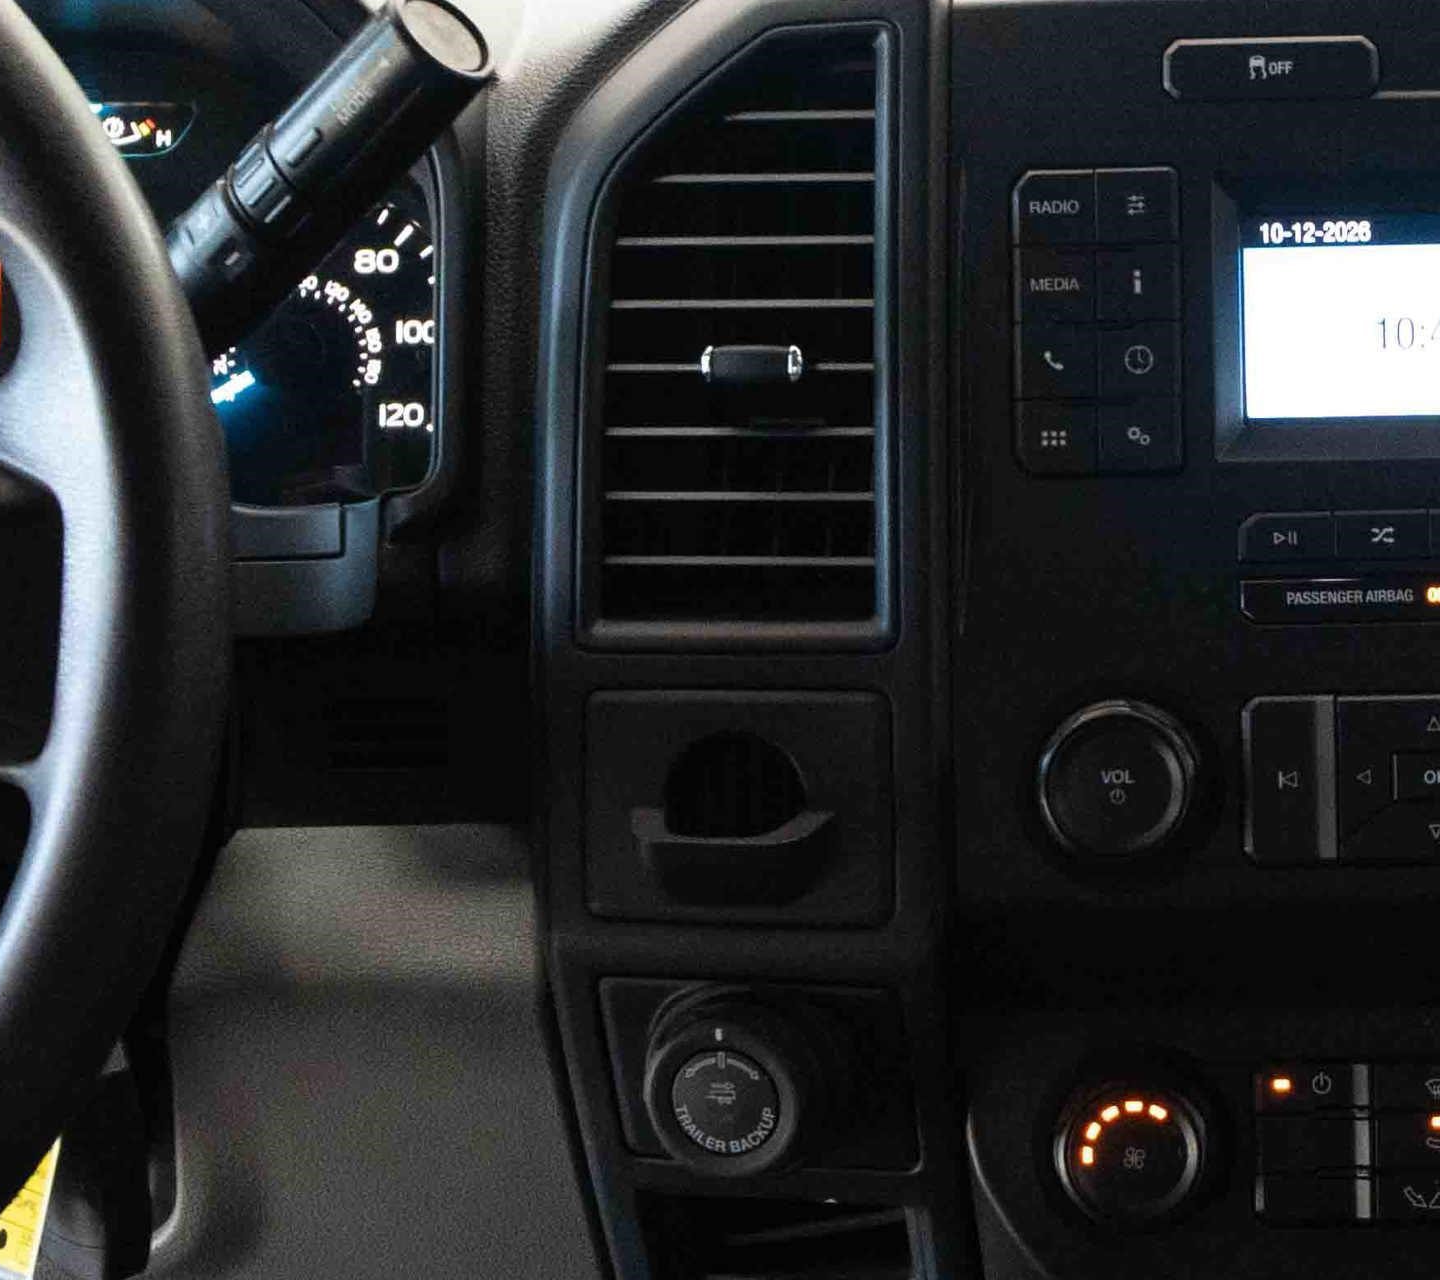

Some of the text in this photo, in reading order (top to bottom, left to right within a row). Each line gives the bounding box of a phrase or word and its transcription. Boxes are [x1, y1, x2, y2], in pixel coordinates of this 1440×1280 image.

[1269, 61, 1294, 75] OFF
[156, 130, 172, 147] H
[1029, 199, 1080, 214] RADIO
[354, 249, 400, 274] 80
[1029, 277, 1080, 291] MEDIA
[396, 320, 435, 344] 100
[380, 402, 424, 427] 120
[1287, 589, 1364, 606] PASSENGER
[1366, 588, 1414, 603] AIRBAG
[1101, 770, 1135, 785] VOL
[676, 1104, 776, 1153] TRAILER BACKUP
